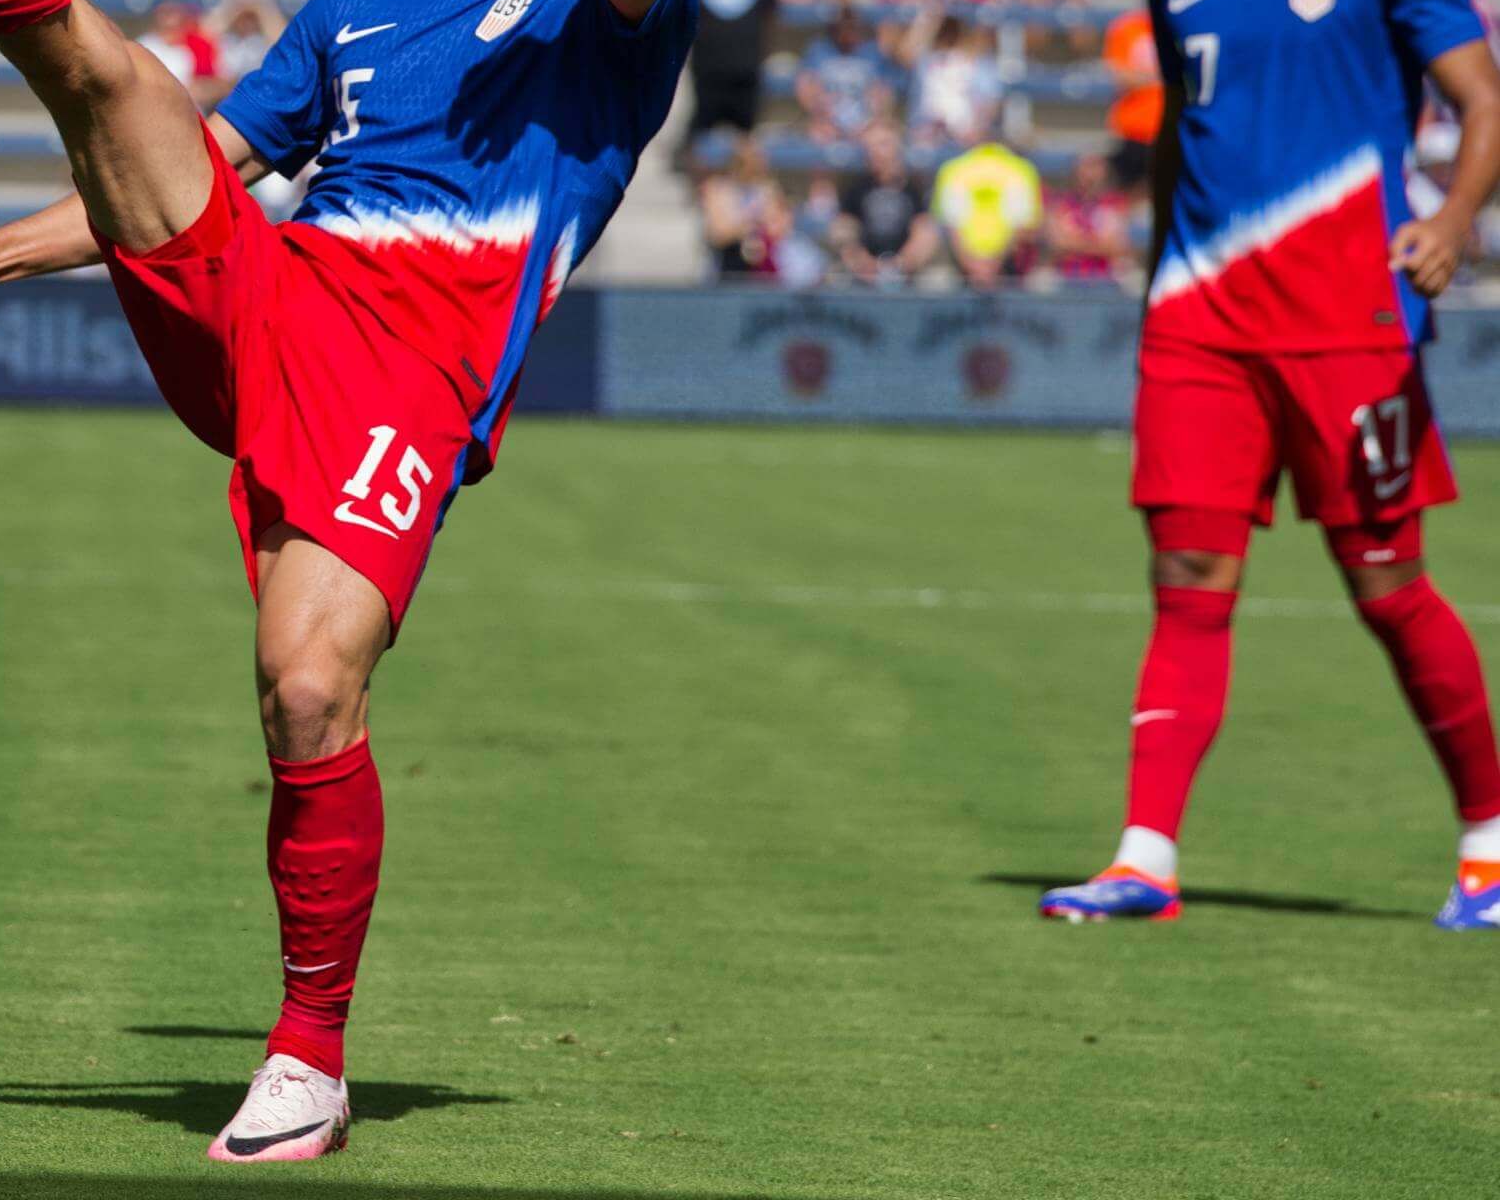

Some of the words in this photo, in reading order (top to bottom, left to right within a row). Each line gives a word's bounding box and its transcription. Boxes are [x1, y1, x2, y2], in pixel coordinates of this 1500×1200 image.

[330, 66, 376, 148] 5
[1180, 32, 1220, 107] 7
[1350, 393, 1411, 476] 17
[341, 423, 434, 531] 15
